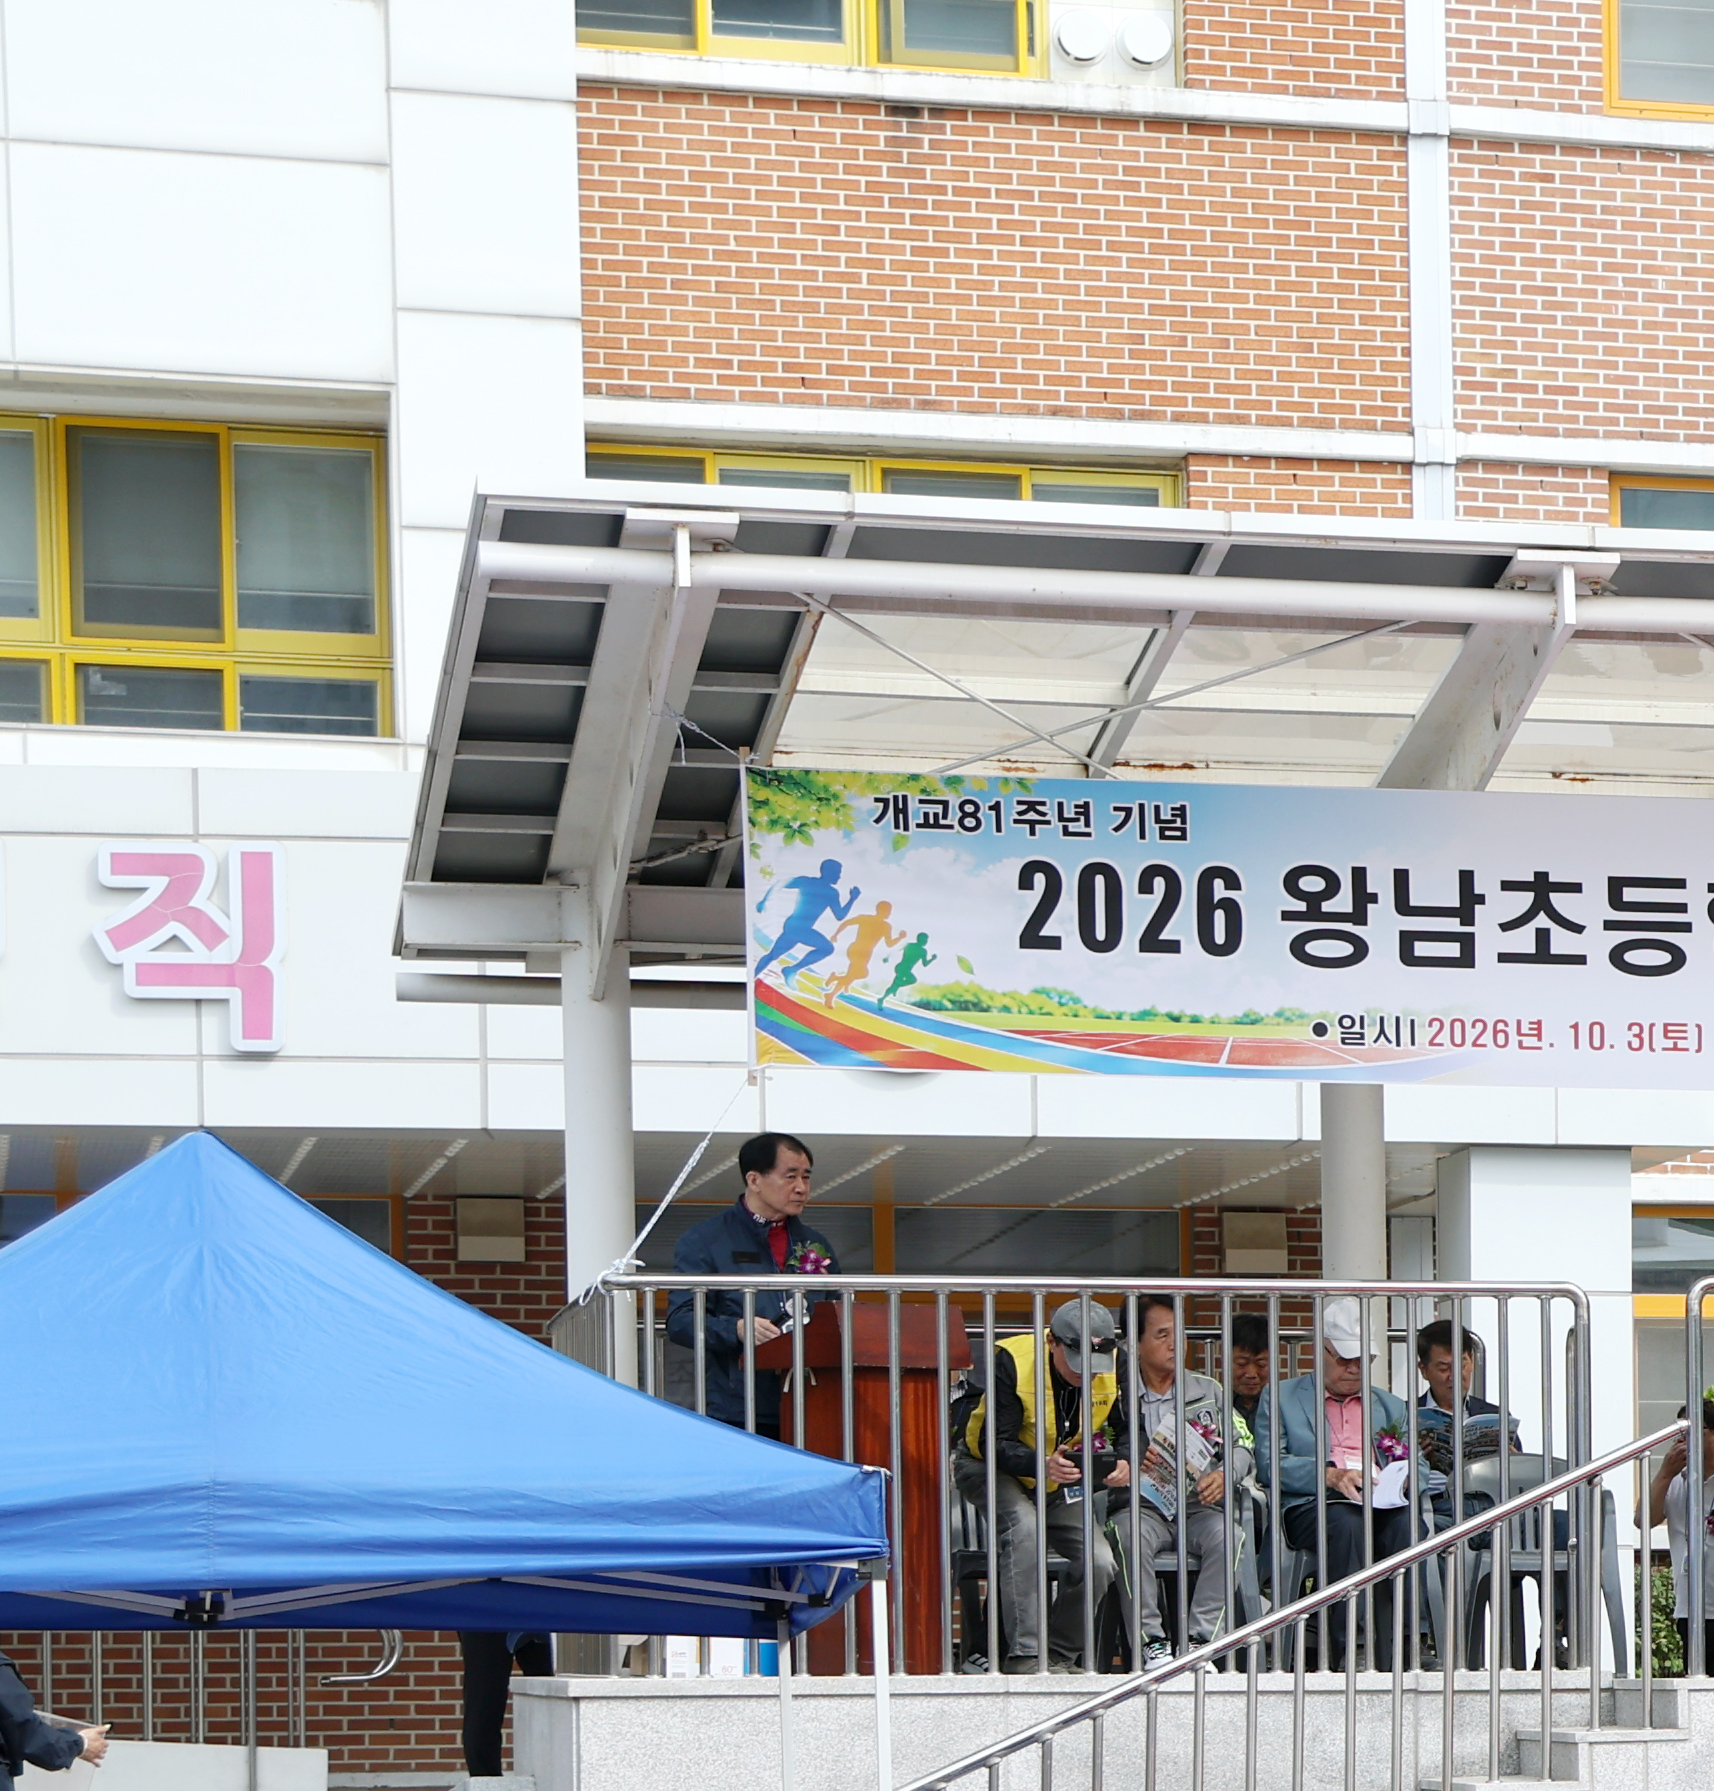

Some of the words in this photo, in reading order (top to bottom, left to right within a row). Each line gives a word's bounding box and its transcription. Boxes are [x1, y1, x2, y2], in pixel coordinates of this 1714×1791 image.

[873, 793, 1094, 839] 개교81주년
[1111, 800, 1190, 842] 기념
[97, 844, 283, 1049] 직
[1018, 859, 1243, 958] 2026
